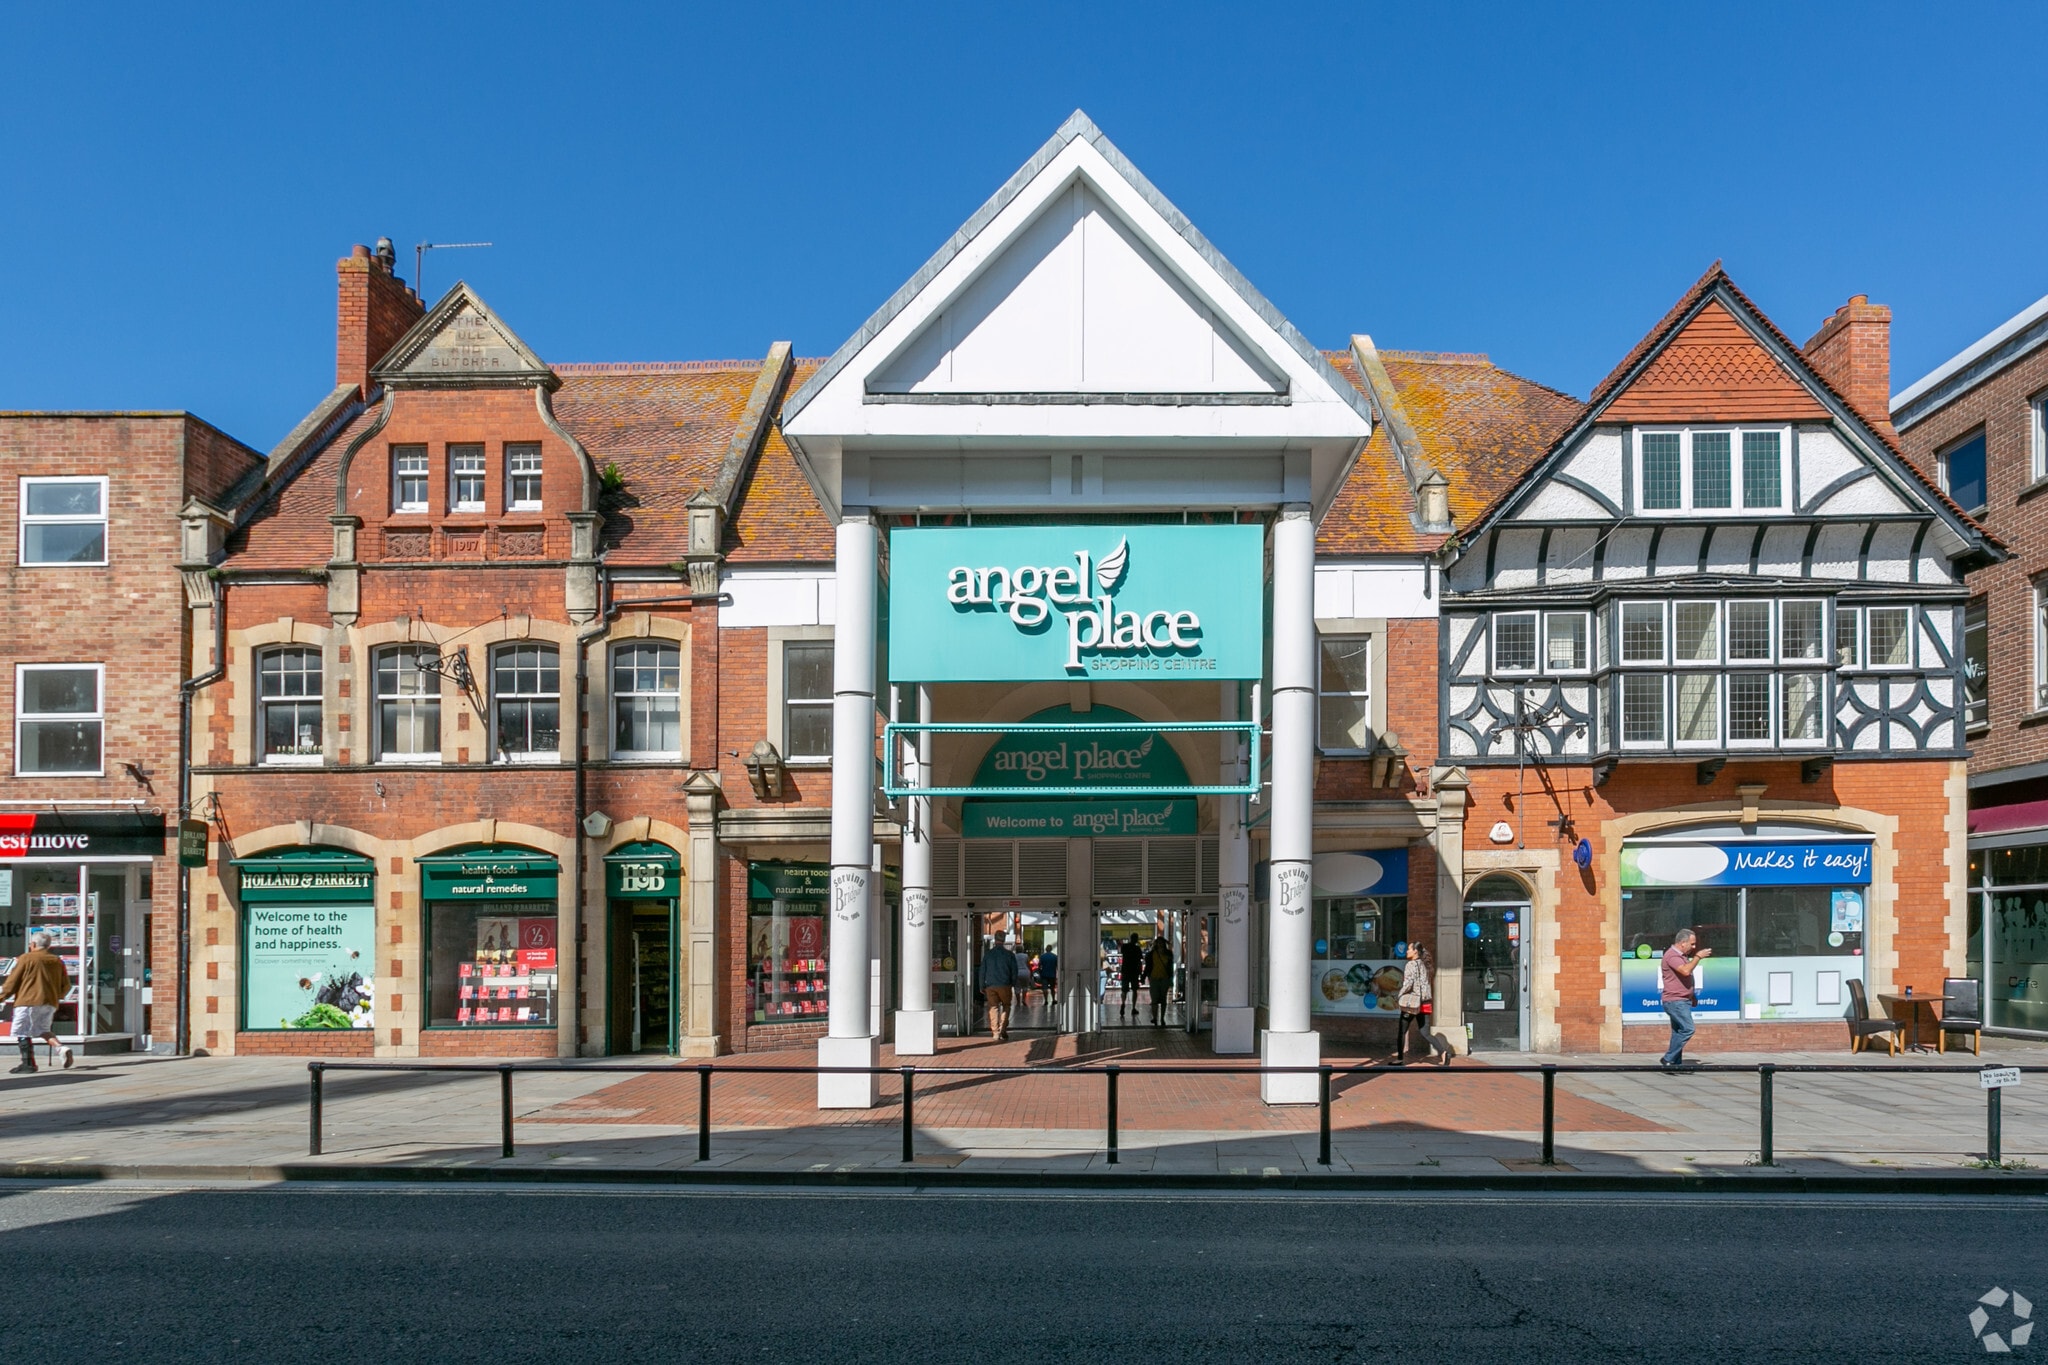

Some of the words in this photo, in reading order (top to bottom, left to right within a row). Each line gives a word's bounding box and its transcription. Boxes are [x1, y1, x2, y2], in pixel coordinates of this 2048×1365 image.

[456, 317, 483, 326] THE
[455, 540, 479, 551] 1907
[947, 550, 1093, 627] angel
[1064, 595, 1201, 669] place
[1091, 659, 1160, 671] SHOPPING
[1163, 659, 1217, 671] CENTRE
[994, 742, 1069, 781] angel
[1073, 742, 1142, 780] place
[1087, 772, 1122, 780] SHOPPING
[1123, 772, 1151, 780] CENTRE
[987, 817, 1046, 828] Welcome
[1050, 817, 1064, 827] to
[1072, 808, 1119, 833] angel
[1122, 807, 1165, 832] place
[1803, 848, 1819, 868] it
[1823, 847, 1869, 877] easy!
[462, 865, 490, 875] health
[492, 864, 518, 874] foods
[242, 873, 300, 889] HOLLAND
[300, 873, 314, 888] &
[314, 872, 371, 888] BARRETT
[485, 875, 494, 884] &
[452, 884, 484, 894] natural
[486, 883, 528, 894] remedies
[775, 886, 804, 894] natural
[255, 911, 311, 922] Welcome
[313, 912, 326, 922] to
[328, 911, 348, 922] the
[254, 925, 288, 936] home
[291, 925, 305, 936] of
[306, 925, 343, 936] health
[254, 939, 277, 950] and
[280, 938, 342, 952] happiness.
[2008, 976, 2039, 989] Cafe
[1642, 999, 1659, 1007] Open
